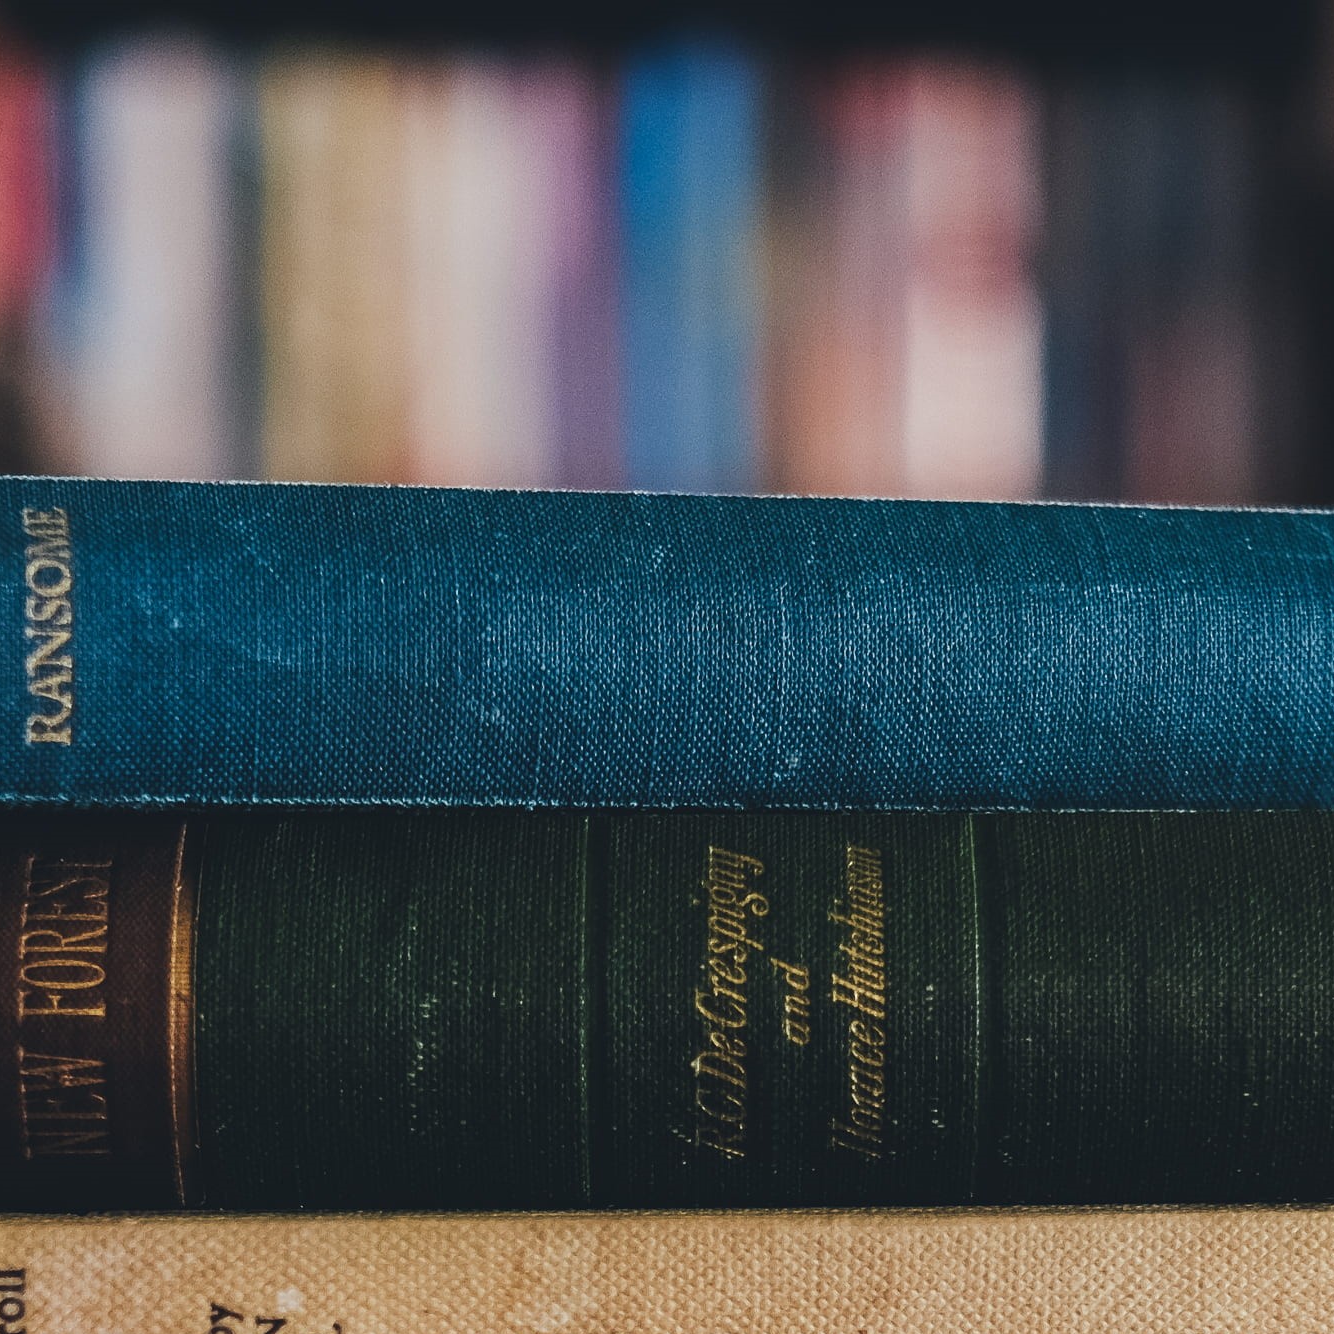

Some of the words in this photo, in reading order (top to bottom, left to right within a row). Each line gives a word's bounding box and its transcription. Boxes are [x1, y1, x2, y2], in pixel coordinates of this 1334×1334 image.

[22, 506, 72, 747] RANSOME
[17, 855, 113, 1023] FOREST
[768, 956, 811, 1045] and
[827, 843, 887, 1019] Hutchinson
[16, 1044, 111, 1160] NEW
